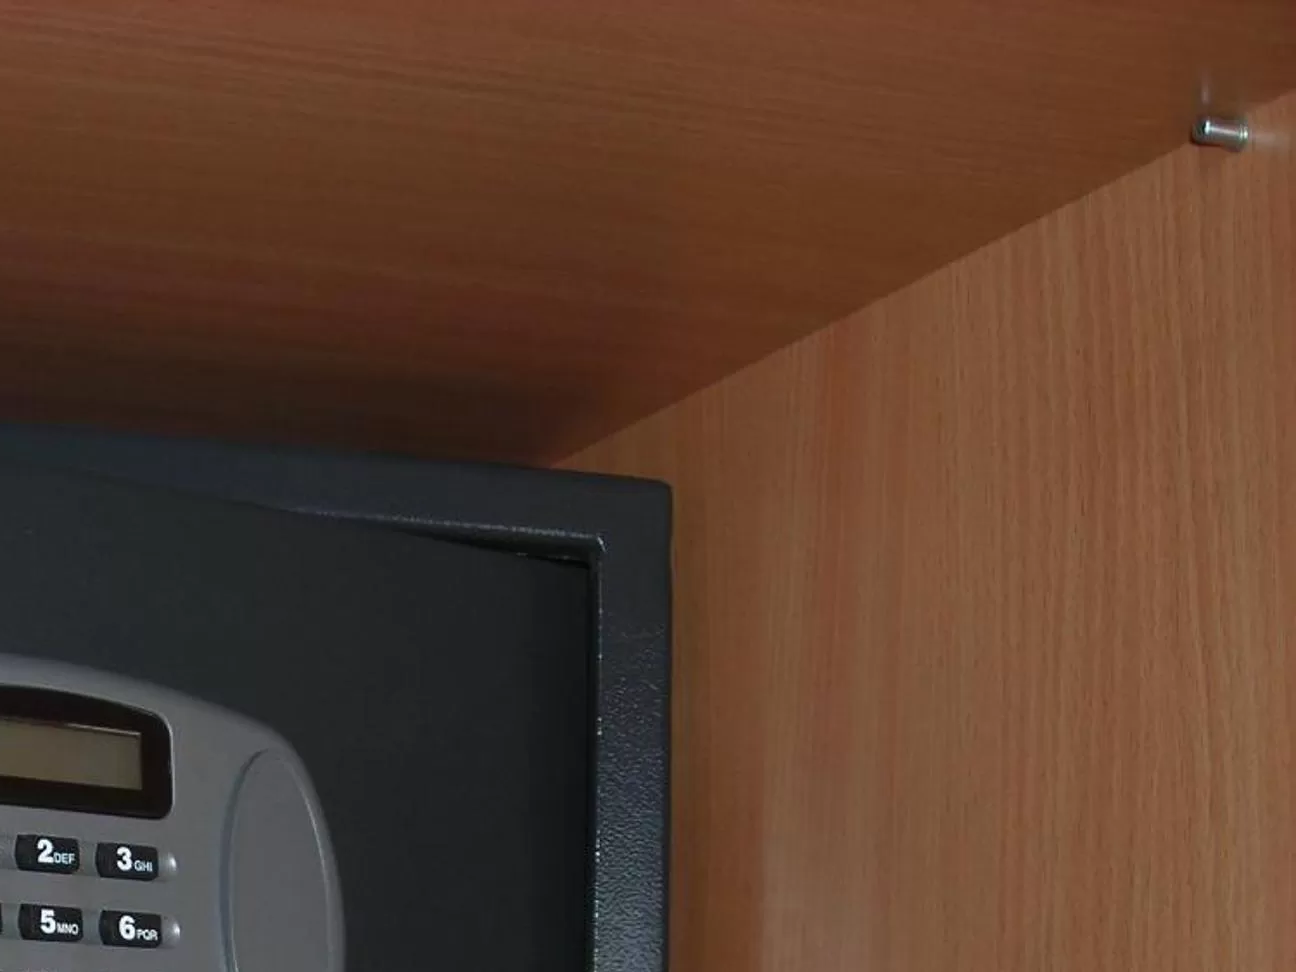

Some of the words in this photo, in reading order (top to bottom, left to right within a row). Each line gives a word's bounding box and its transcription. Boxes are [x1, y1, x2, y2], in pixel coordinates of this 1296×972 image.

[37, 839, 54, 863] 2
[54, 852, 76, 865] DEF
[117, 846, 133, 871] 3
[134, 860, 153, 872] GHI
[40, 908, 56, 934] 5
[118, 915, 136, 941] 6
